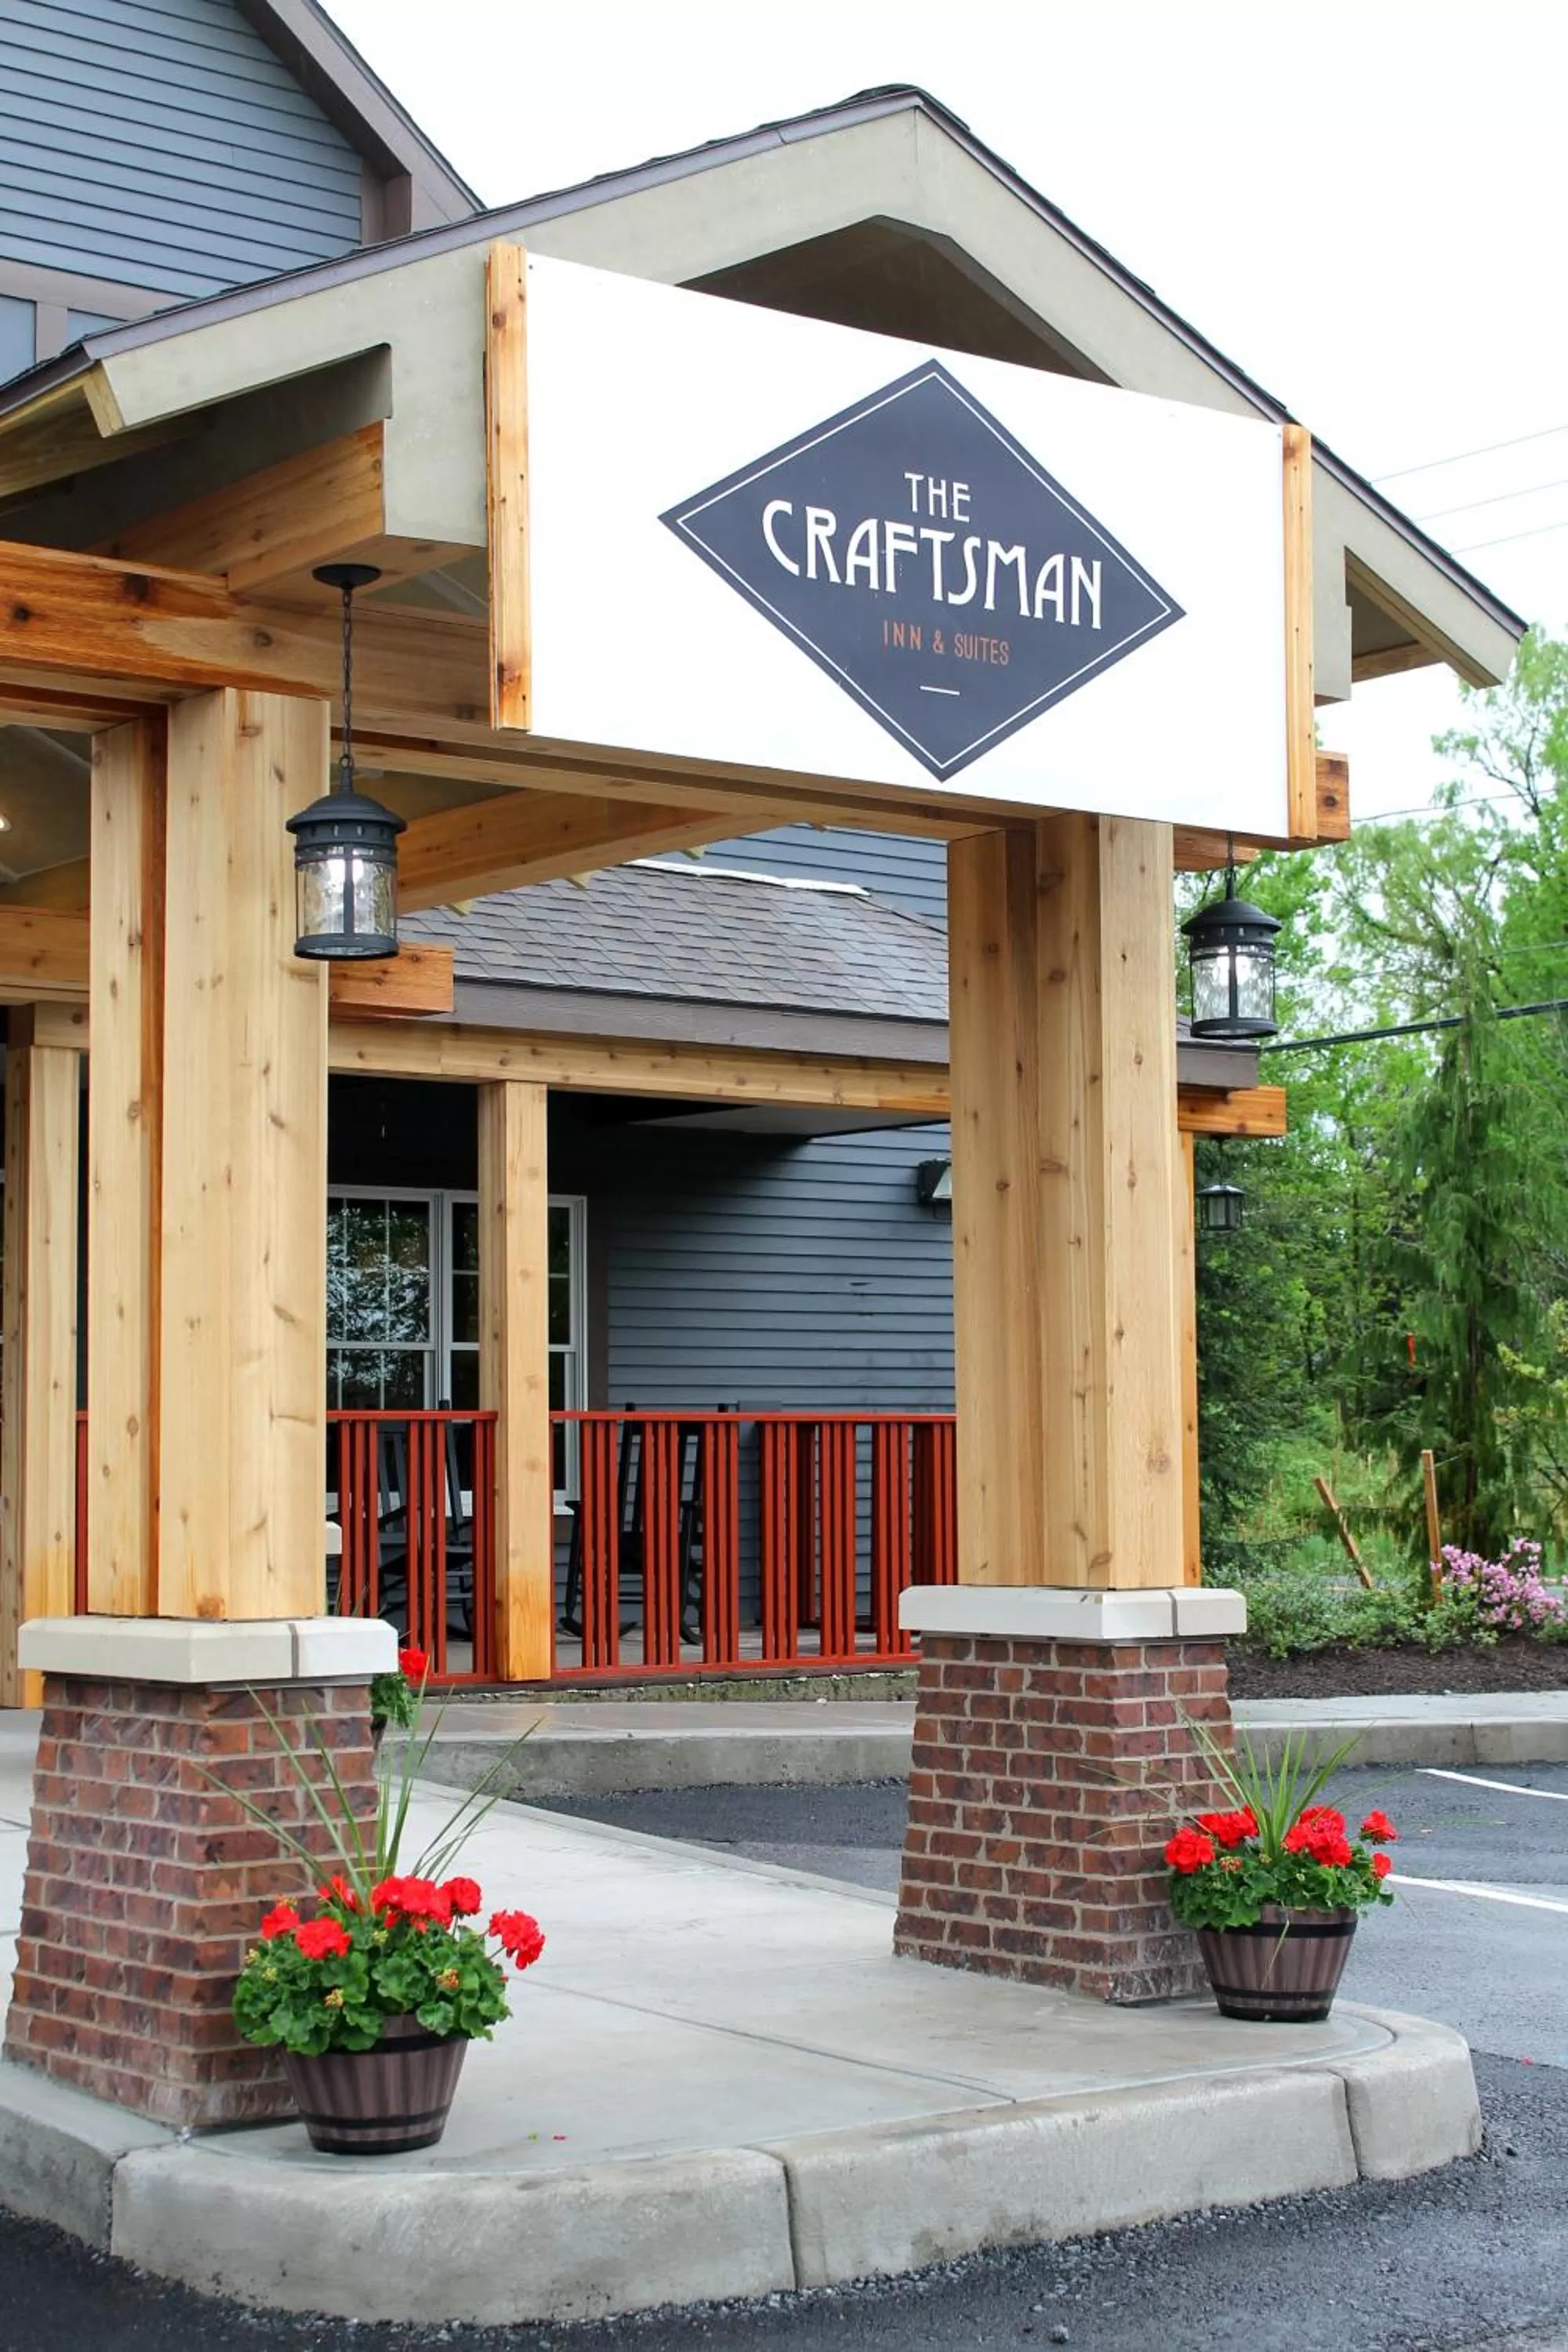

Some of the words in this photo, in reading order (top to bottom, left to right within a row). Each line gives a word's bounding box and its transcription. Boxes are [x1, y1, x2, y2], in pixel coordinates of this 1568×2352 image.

[904, 471, 971, 524] THE
[761, 499, 1102, 630] CRAFTSMAN
[883, 619, 922, 652] INN
[933, 629, 946, 655] &
[954, 633, 1011, 666] SUITES
